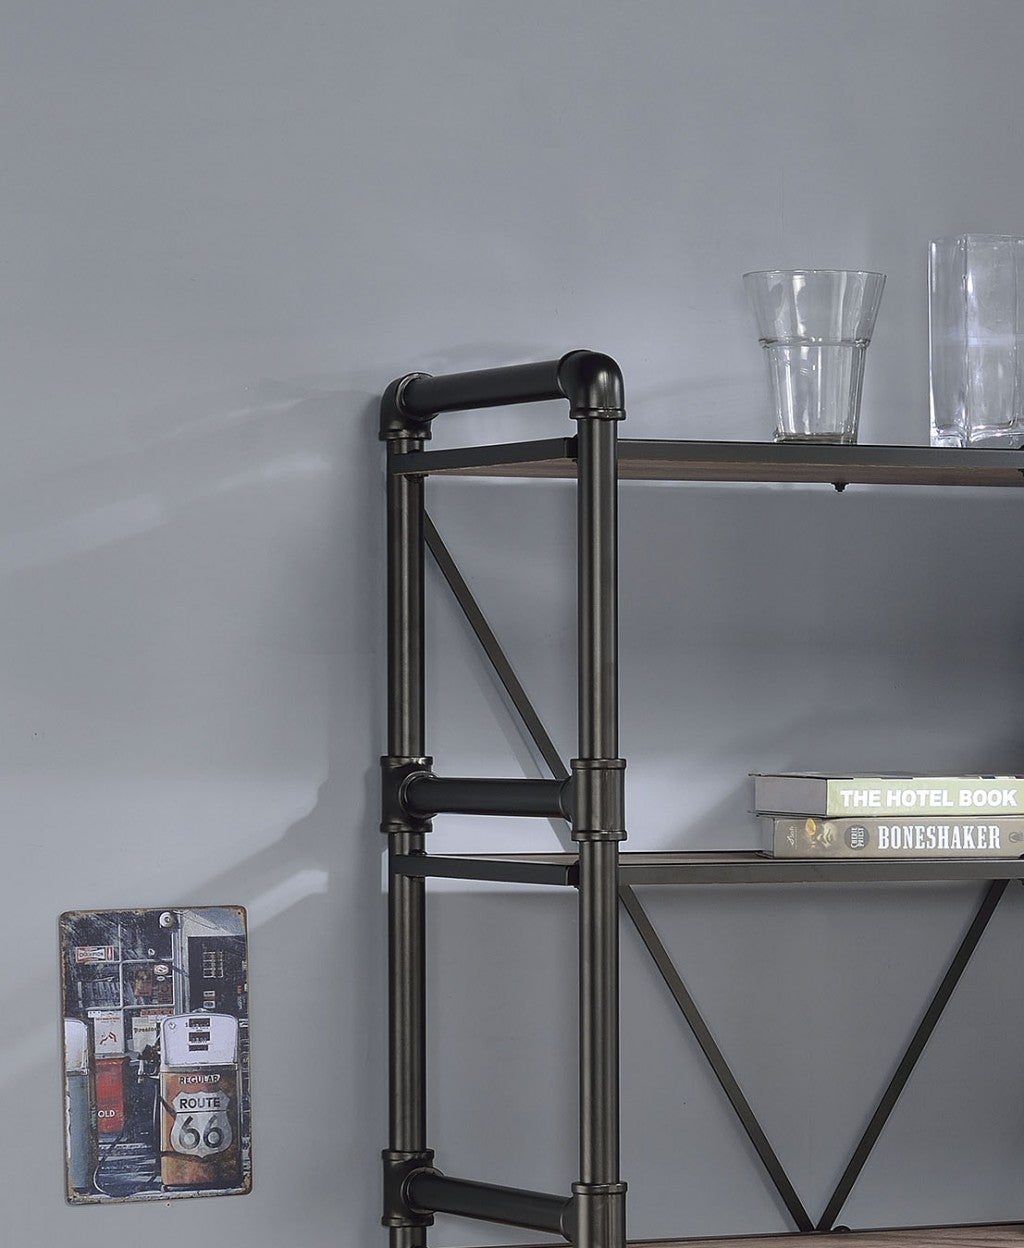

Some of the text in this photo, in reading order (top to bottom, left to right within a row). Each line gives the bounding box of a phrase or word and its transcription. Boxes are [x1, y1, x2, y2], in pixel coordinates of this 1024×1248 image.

[840, 790, 881, 808] THE
[887, 790, 954, 807] HOTEL
[959, 789, 1018, 807] BOOK
[877, 825, 1001, 850] BONESHAKER
[179, 1073, 221, 1085] REGULAR
[179, 1096, 221, 1110] ROUTE
[178, 1115, 225, 1149] 66
